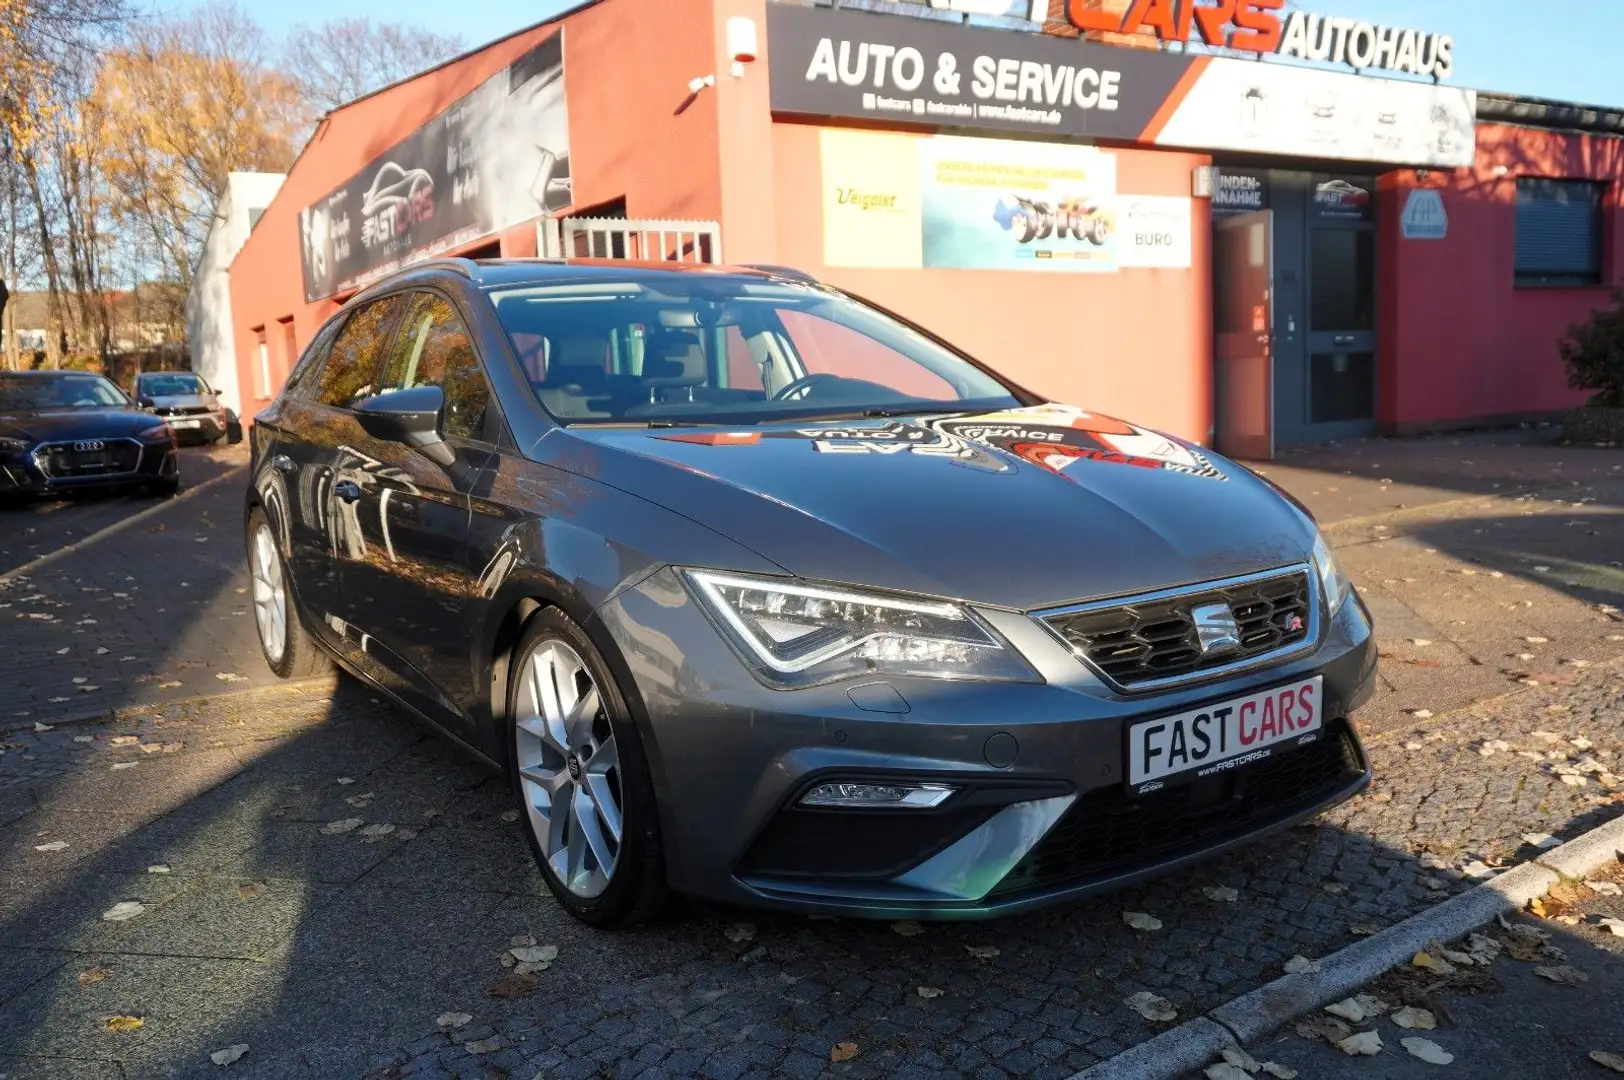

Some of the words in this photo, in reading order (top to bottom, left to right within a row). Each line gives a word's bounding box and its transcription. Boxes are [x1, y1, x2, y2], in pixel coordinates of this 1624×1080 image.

[805, 37, 925, 92] AUTO
[933, 51, 961, 95] &
[971, 55, 1121, 111] SERVICE
[1279, 11, 1454, 79] AUTOHAUS
[1144, 707, 1233, 775] FAST
[1239, 684, 1314, 746] CARS
